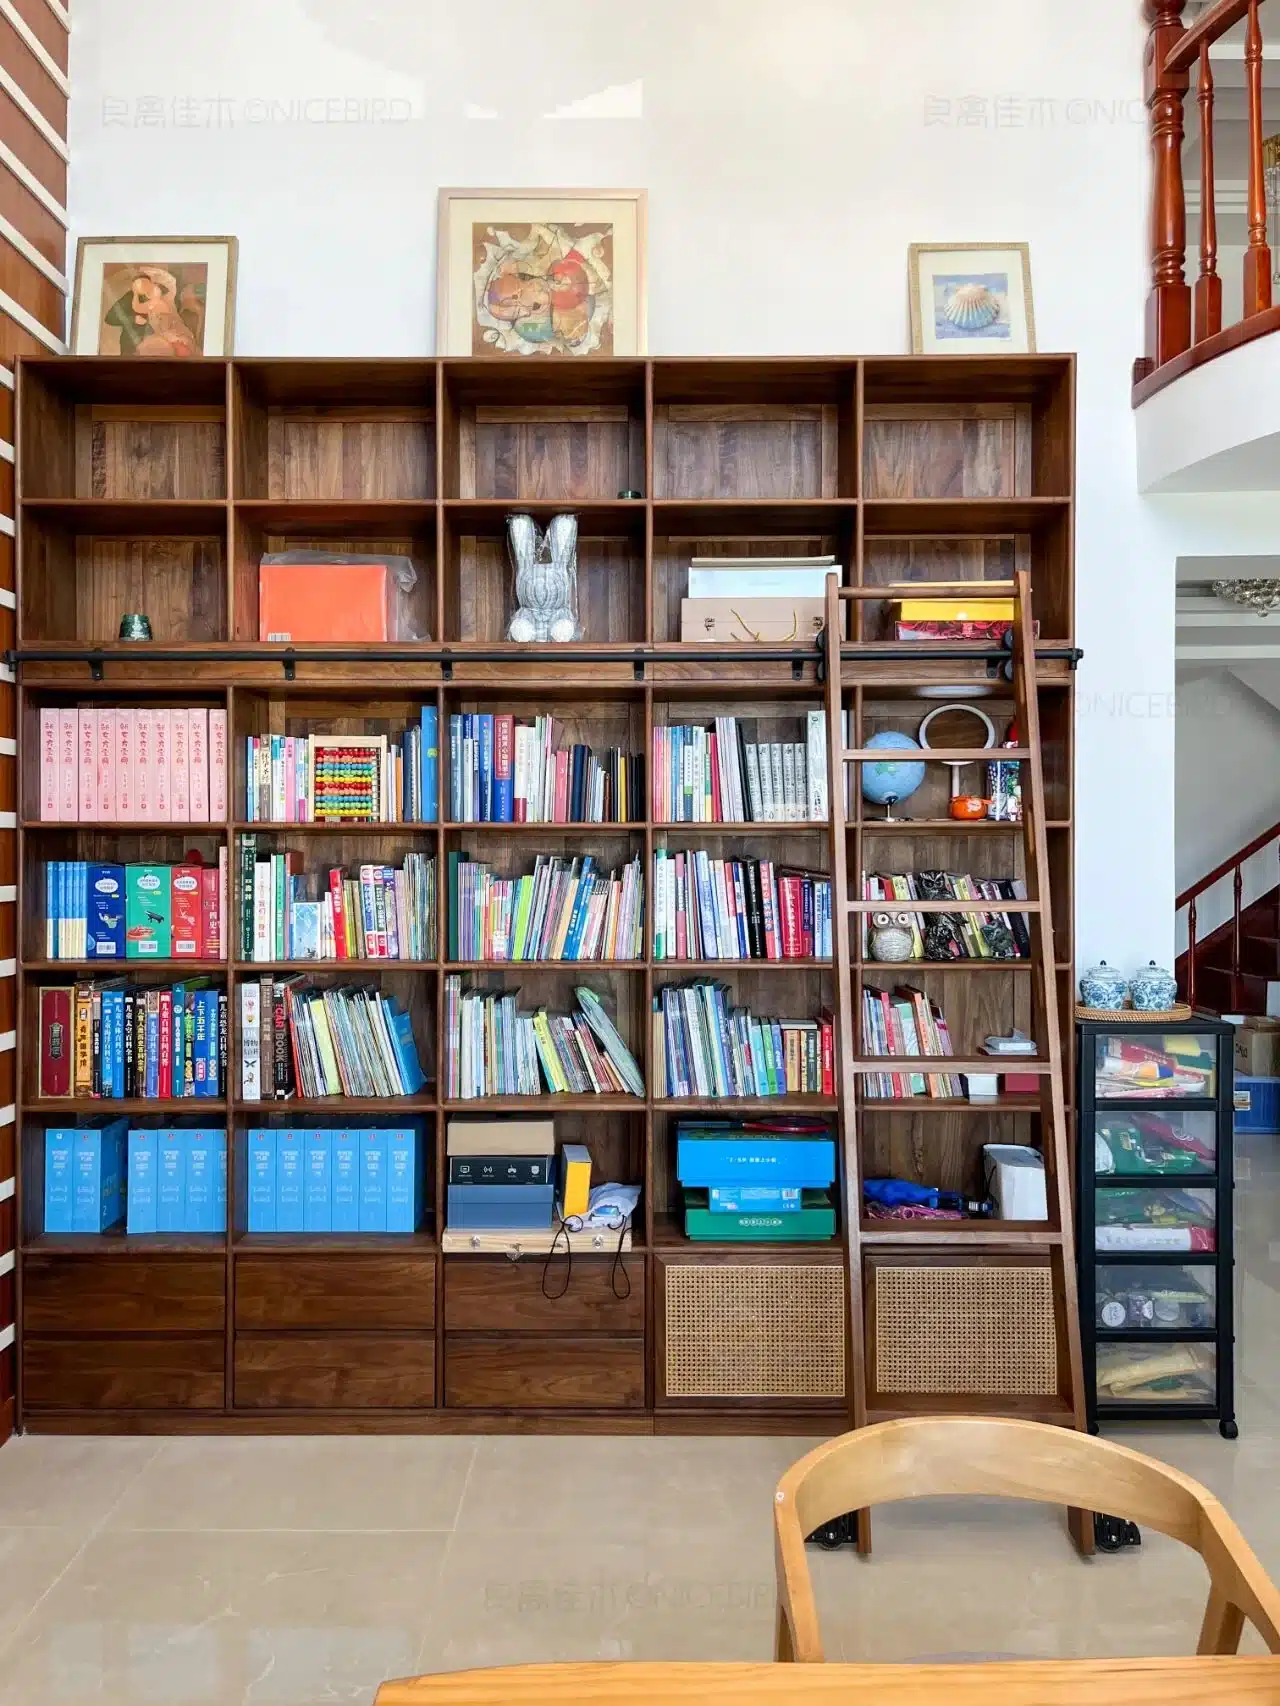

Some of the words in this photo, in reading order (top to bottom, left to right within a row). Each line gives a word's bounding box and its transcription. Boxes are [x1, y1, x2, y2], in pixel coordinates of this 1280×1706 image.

[197, 1001, 206, 1041] 上下五千年
[275, 1007, 284, 1030] CAR
[275, 1033, 284, 1062] BOOK
